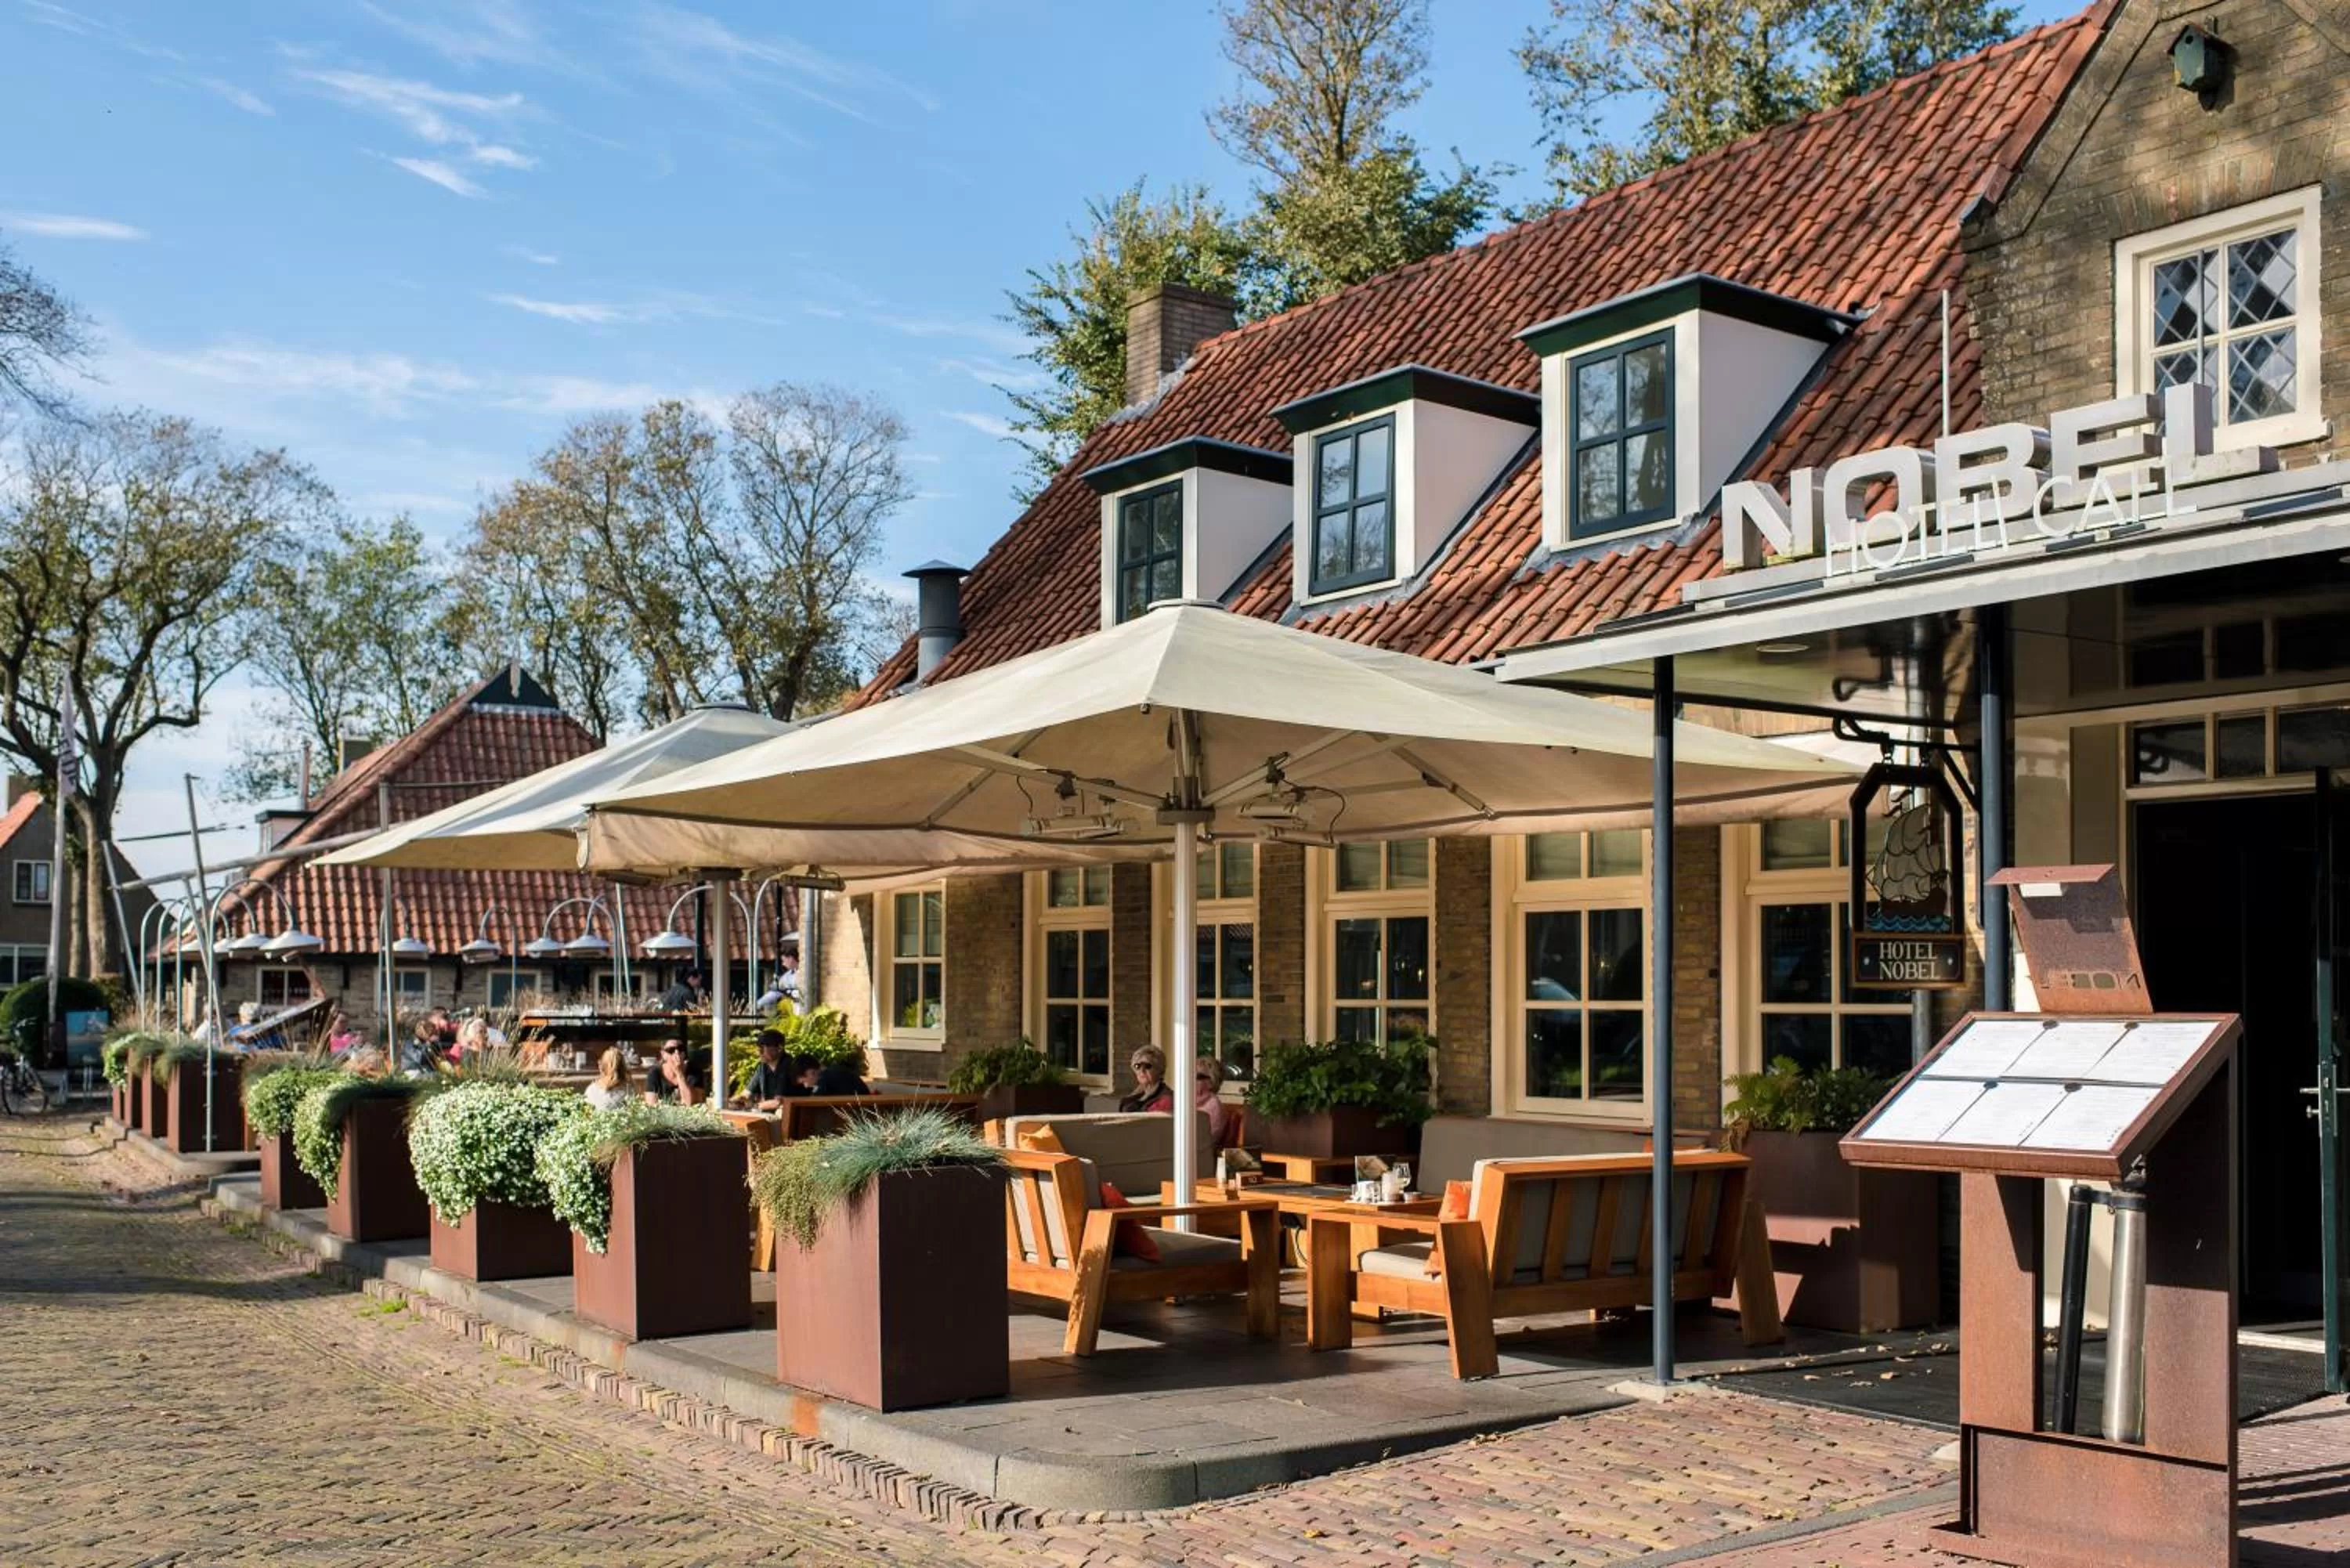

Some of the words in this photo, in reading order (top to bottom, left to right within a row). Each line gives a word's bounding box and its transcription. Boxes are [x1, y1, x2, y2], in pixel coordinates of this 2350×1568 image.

[1723, 382, 2279, 569] NOBEL
[1825, 493, 1998, 576] HOTEL
[1880, 941, 1938, 959] HOTEL
[1880, 961, 1940, 980] NOBEL
